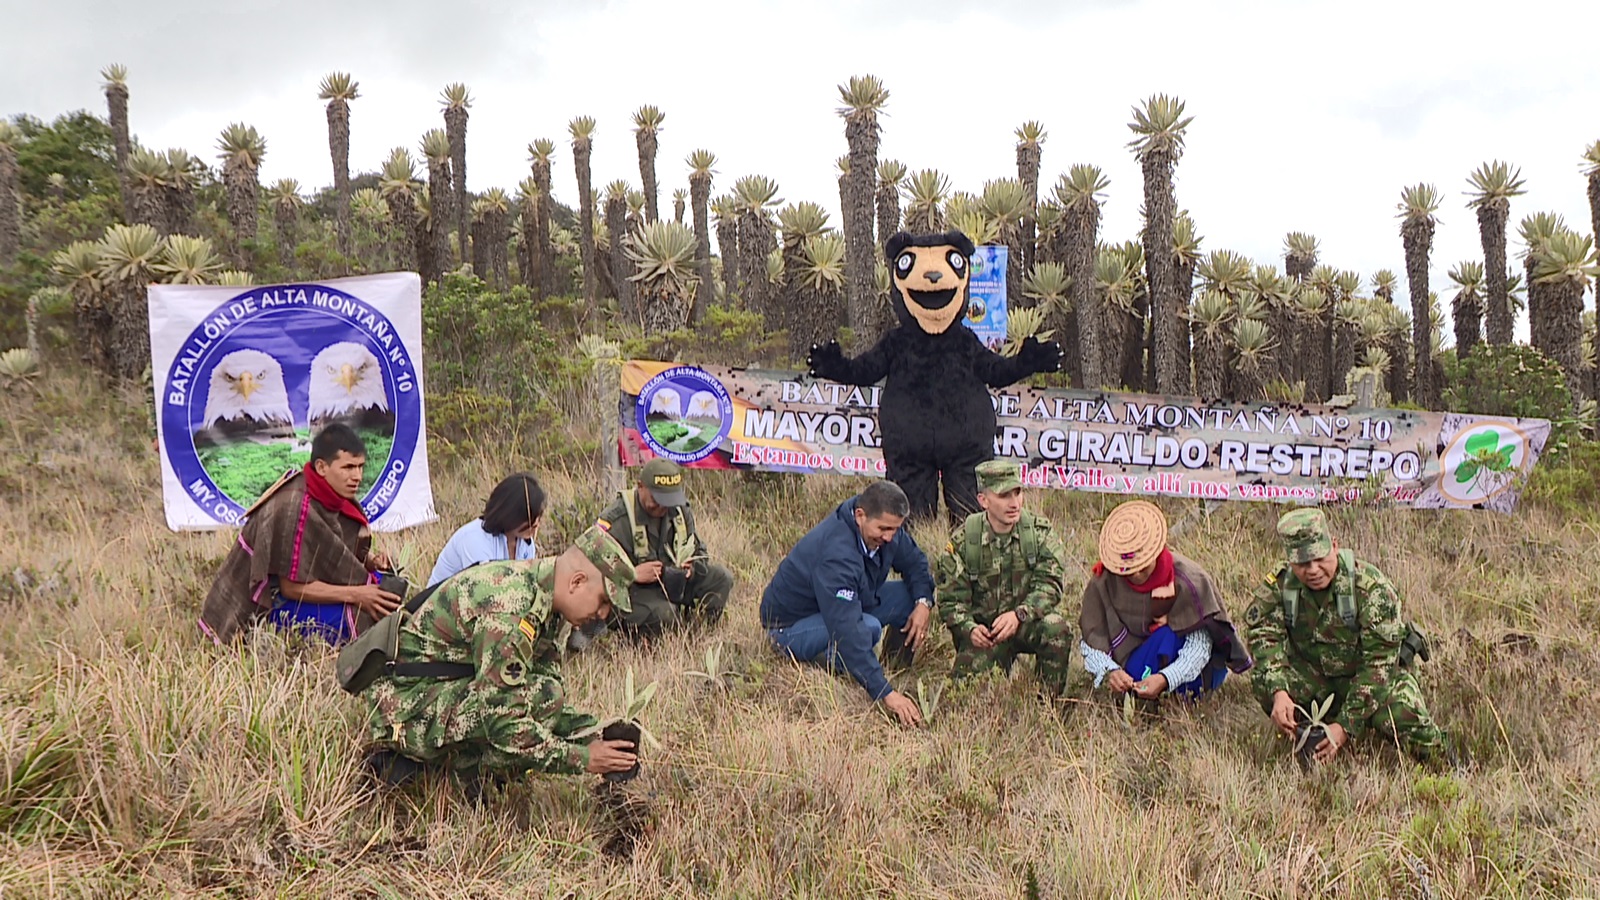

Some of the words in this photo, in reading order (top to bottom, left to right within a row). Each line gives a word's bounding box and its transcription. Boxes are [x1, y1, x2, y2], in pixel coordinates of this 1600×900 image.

[169, 313, 231, 406] BATALLÓN
[229, 296, 258, 320] DE
[261, 289, 308, 309] ALTA
[312, 290, 393, 349] MONTAÑA
[397, 371, 412, 392] 10
[1027, 396, 1118, 424] ALTA
[1124, 402, 1302, 435] MONTAÑA
[1359, 417, 1392, 442] 10
[731, 441, 834, 469] Estamos
[840, 455, 868, 472] en
[1054, 465, 1116, 488] Valle
[1121, 475, 1138, 493] y
[1143, 472, 1183, 495] allí
[1188, 480, 1230, 499] nos
[1236, 483, 1316, 499] vamos
[1322, 485, 1338, 500] a
[1039, 428, 1209, 468] GIRALDO
[1220, 440, 1421, 480] RESTREPO
[189, 478, 216, 508] MY.
[363, 459, 405, 519] STREPO
